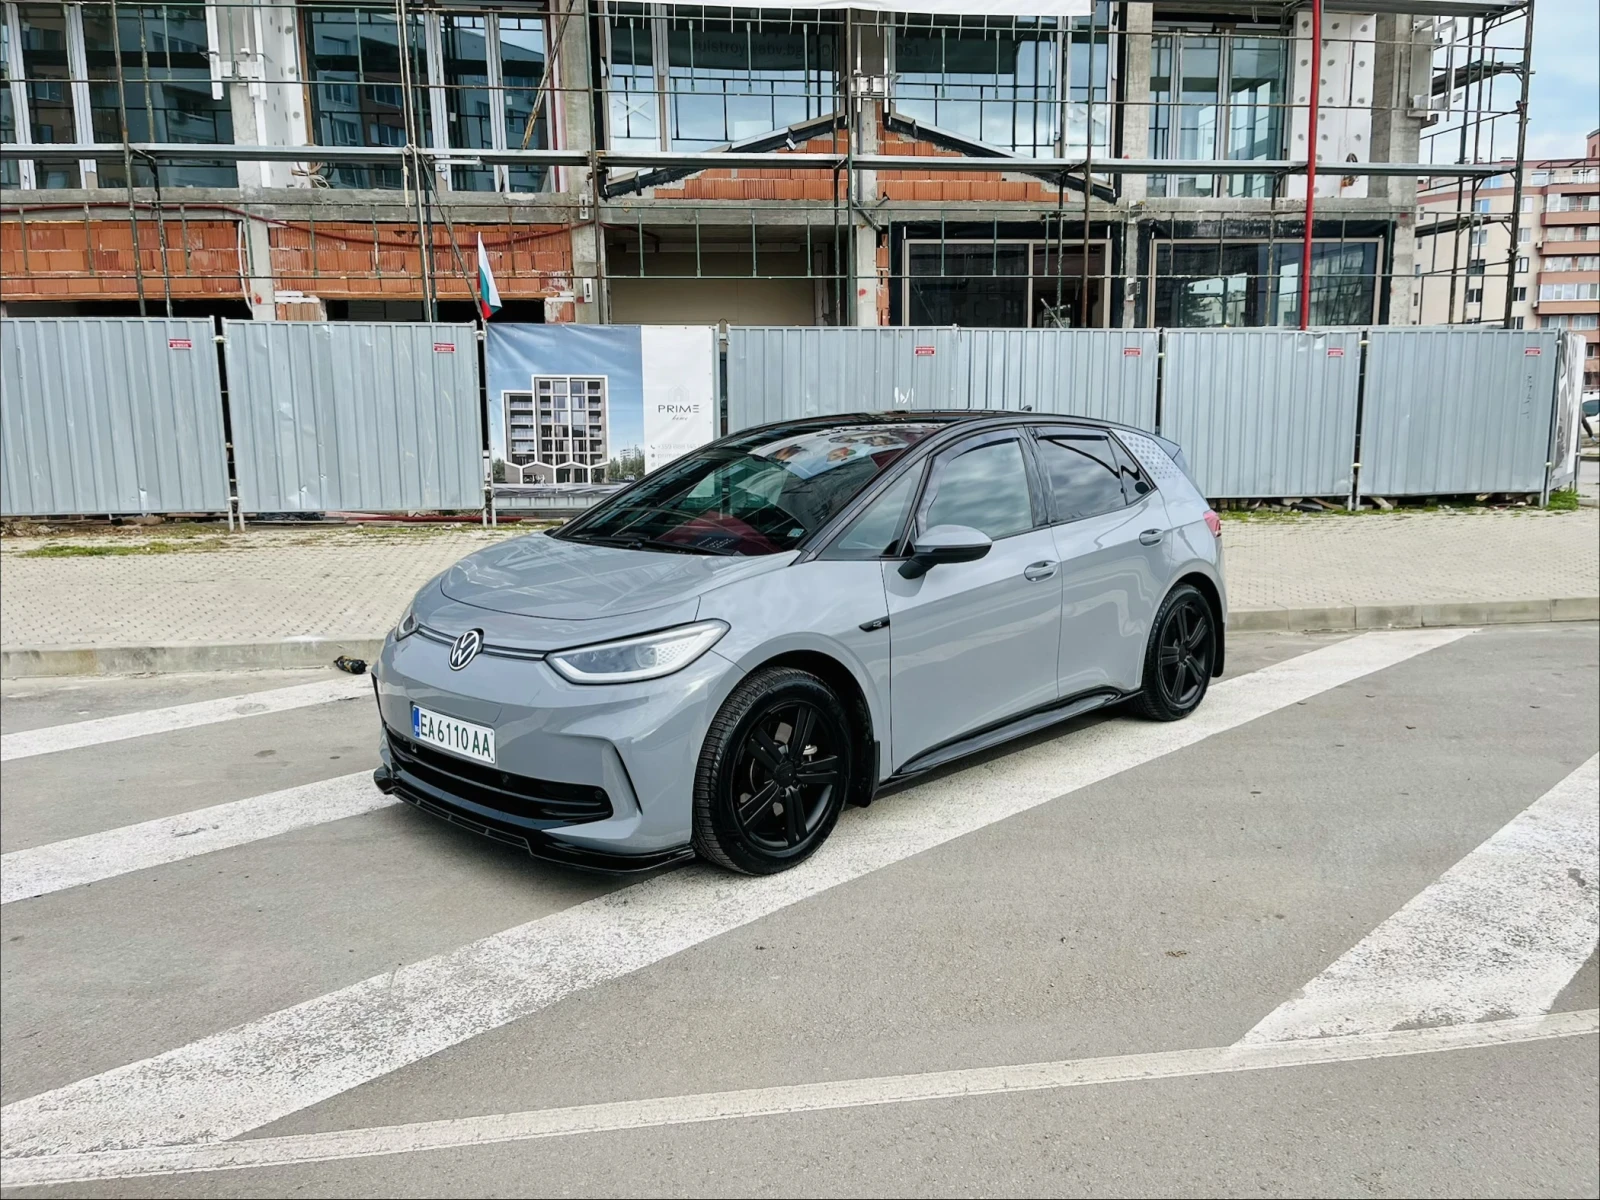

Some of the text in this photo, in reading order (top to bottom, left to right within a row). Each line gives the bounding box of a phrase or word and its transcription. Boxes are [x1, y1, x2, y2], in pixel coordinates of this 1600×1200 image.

[658, 404, 700, 413] PRIME
[420, 713, 491, 758] EA 6110 AA
